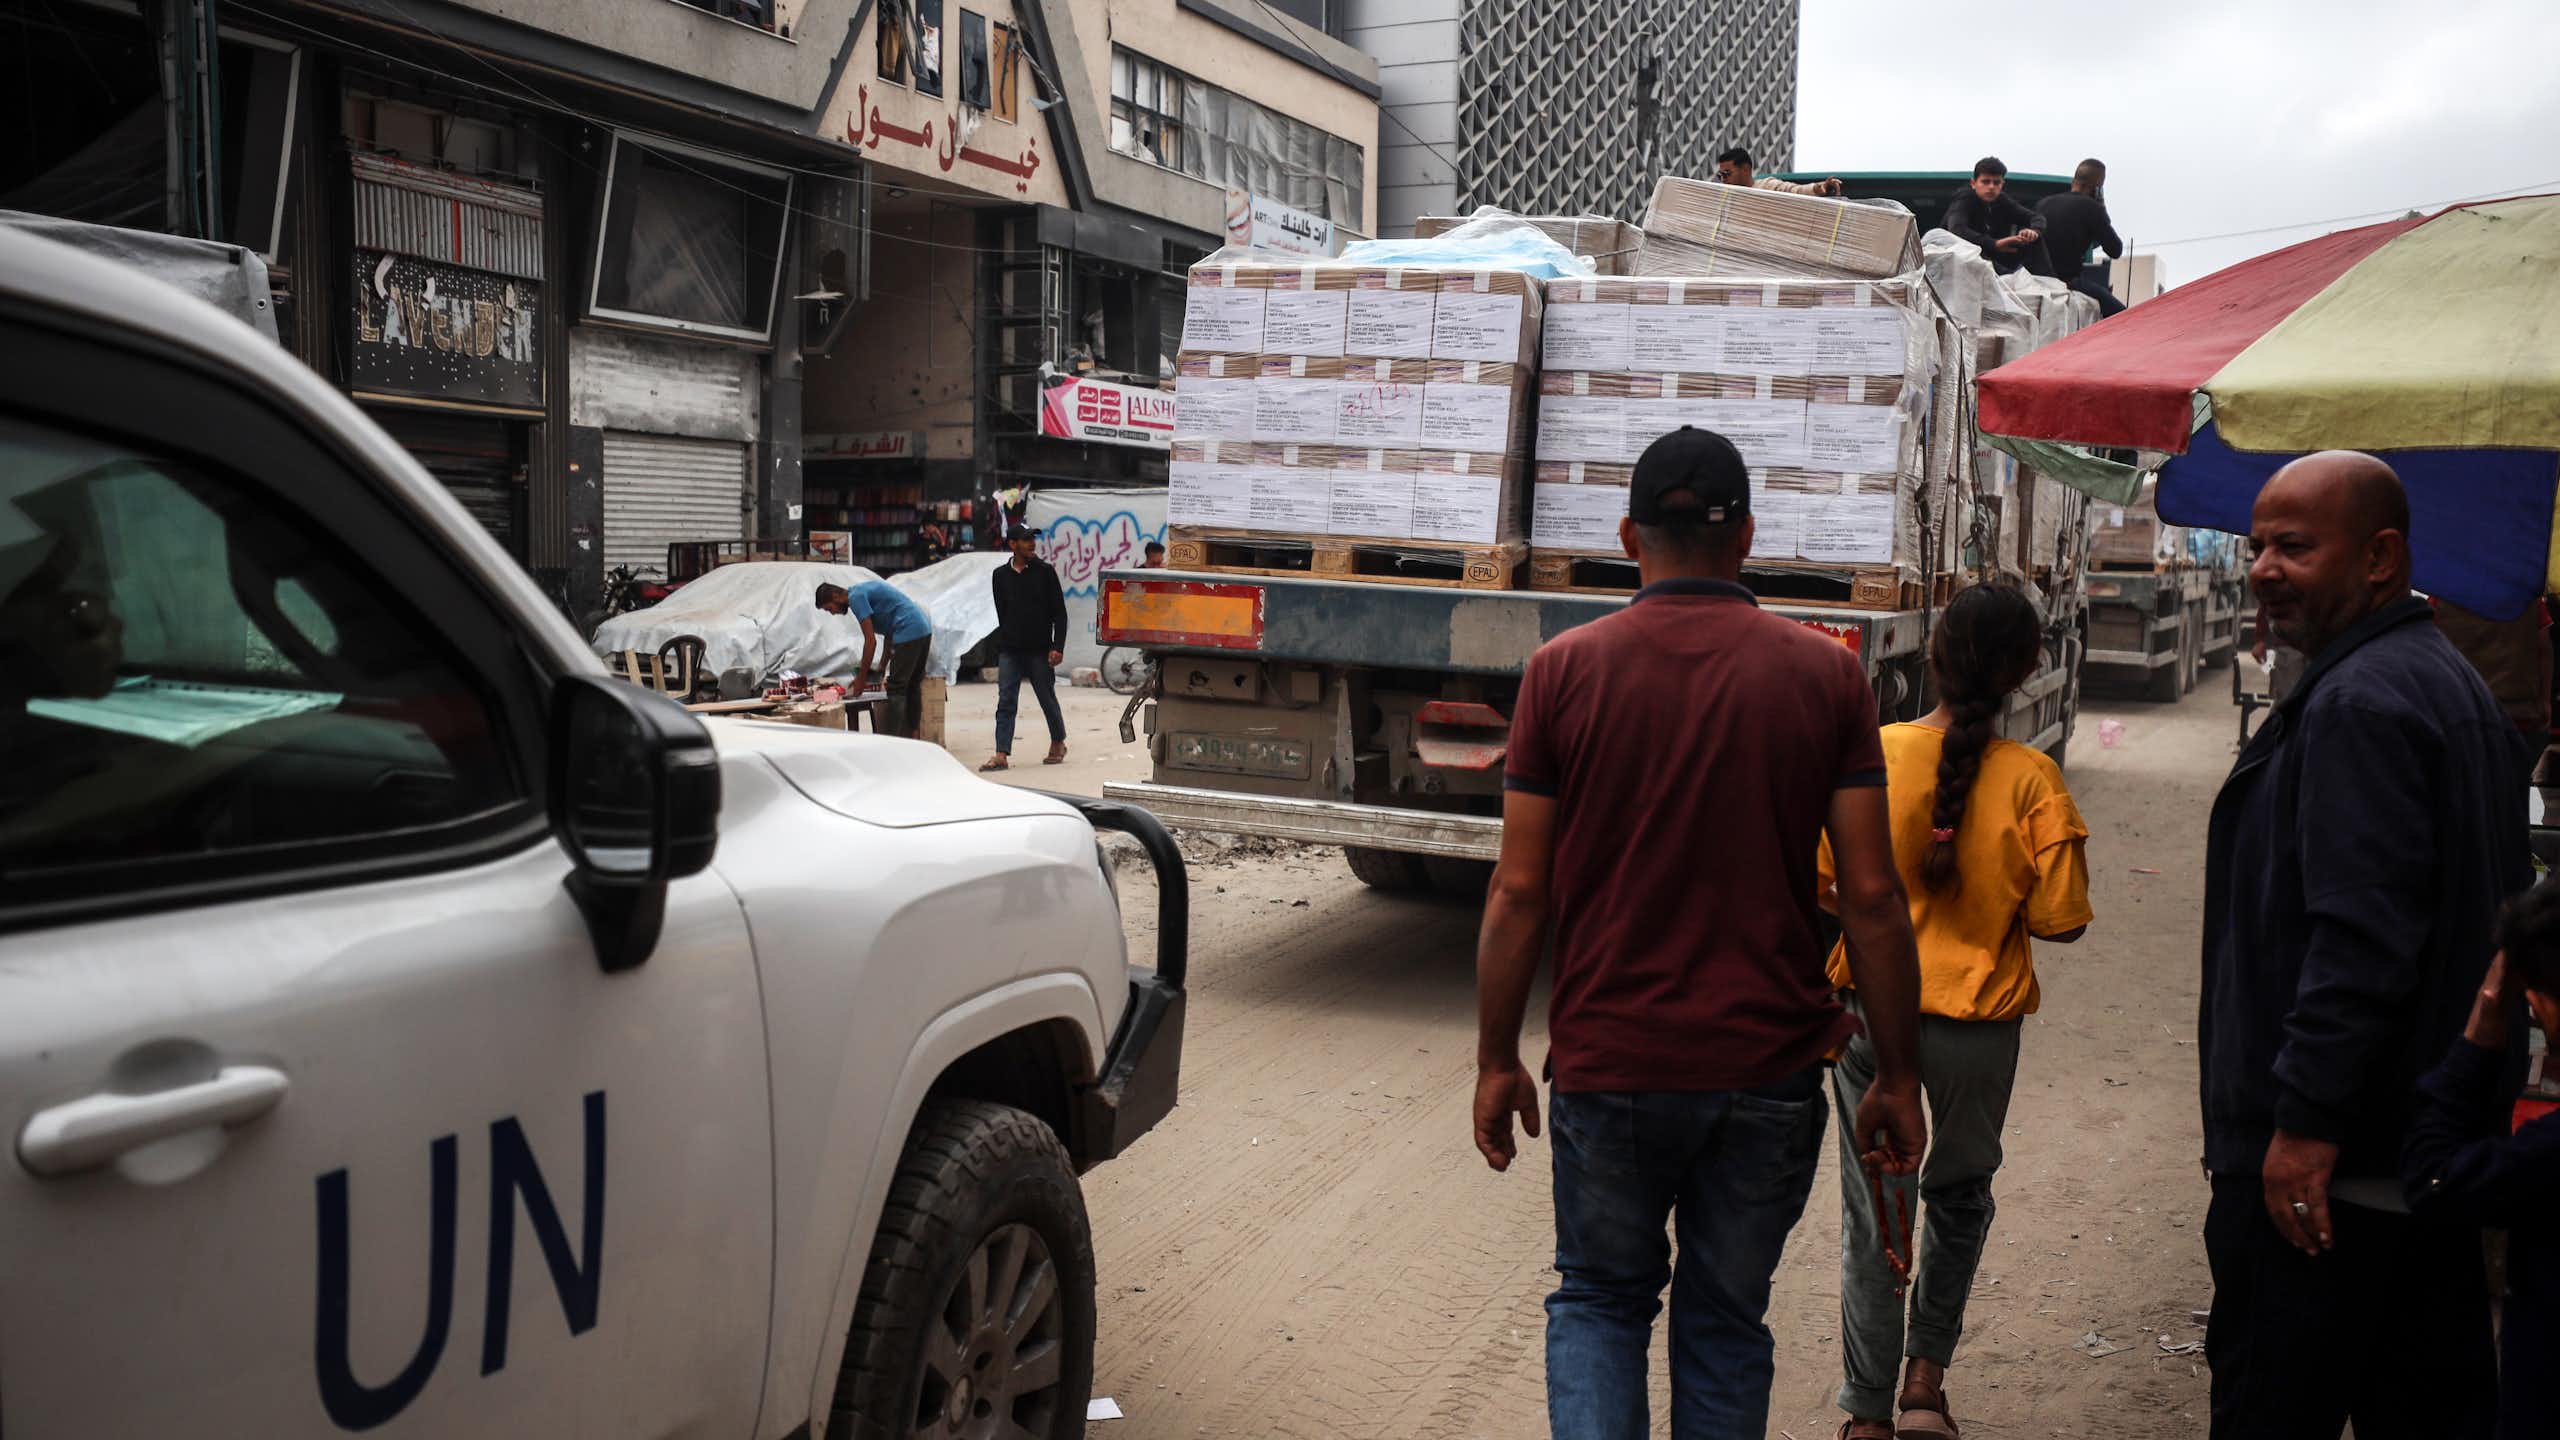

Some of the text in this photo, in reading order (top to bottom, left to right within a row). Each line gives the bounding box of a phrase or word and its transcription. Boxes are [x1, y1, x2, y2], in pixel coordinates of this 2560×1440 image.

[847, 83, 1040, 193] خيل مول
[1254, 210, 1267, 224] ART
[360, 284, 532, 363] LAVENDER
[1131, 395, 1175, 419] ALSH
[1473, 566, 1495, 578] EPAL
[315, 1089, 606, 1432] UN
